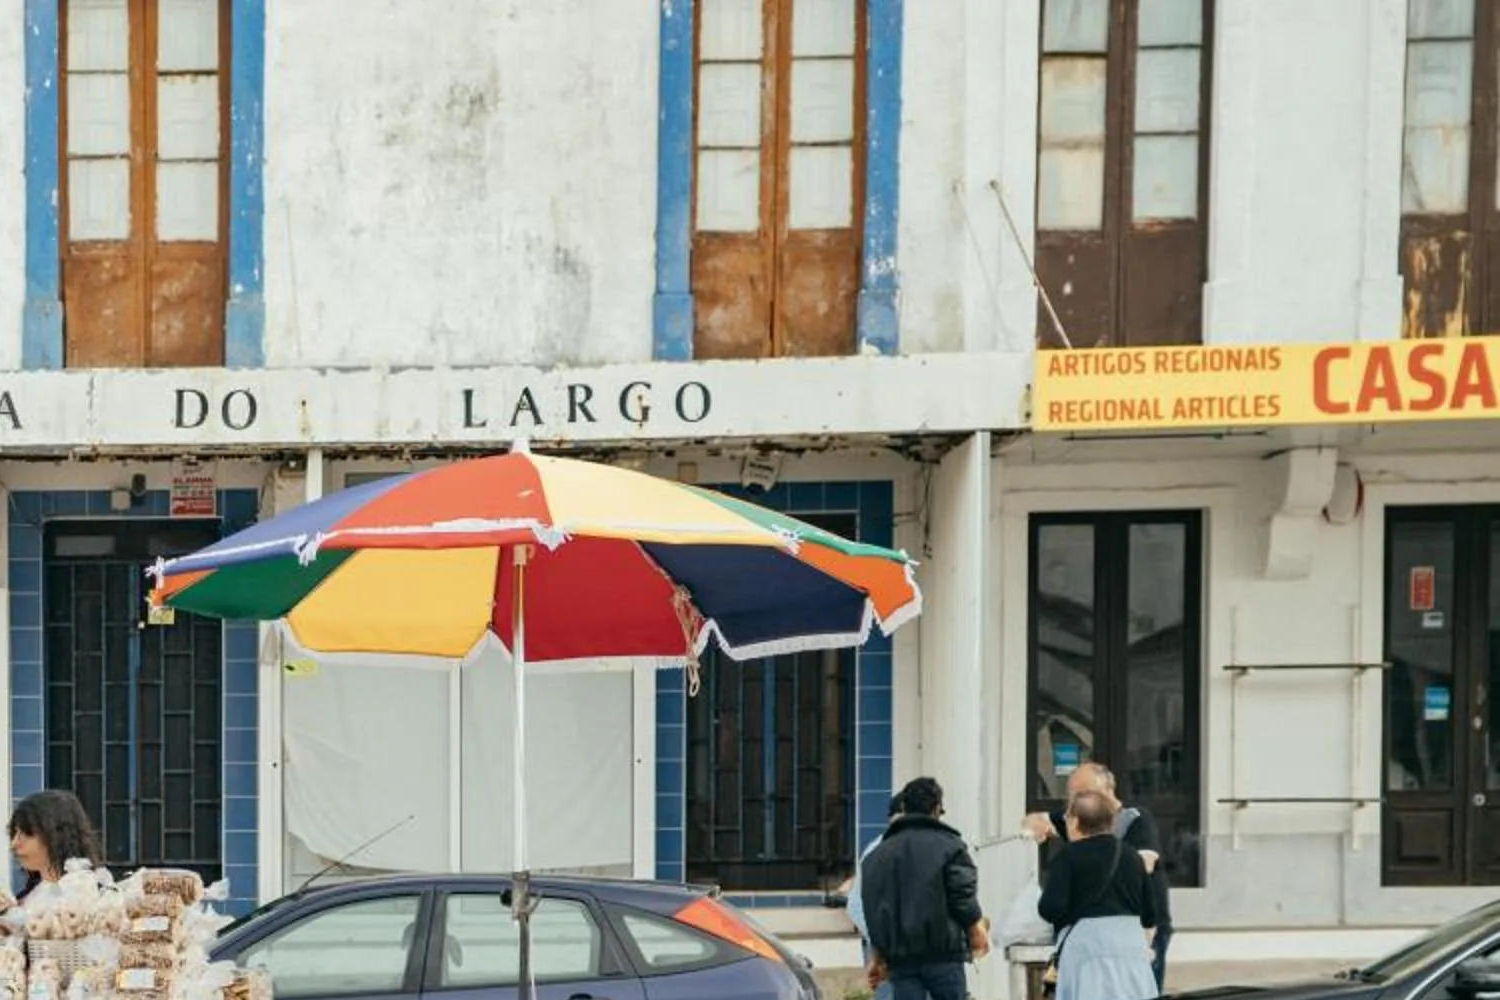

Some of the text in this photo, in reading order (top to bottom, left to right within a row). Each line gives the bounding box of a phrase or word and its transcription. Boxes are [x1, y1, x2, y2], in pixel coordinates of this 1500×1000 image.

[1048, 347, 1282, 376] ARTIGOS REGIONAIS
[1312, 343, 1498, 415] CASA
[173, 388, 258, 431] DO
[461, 380, 712, 429] LARGO
[1048, 395, 1281, 423] REGIONAL ARTICLES
